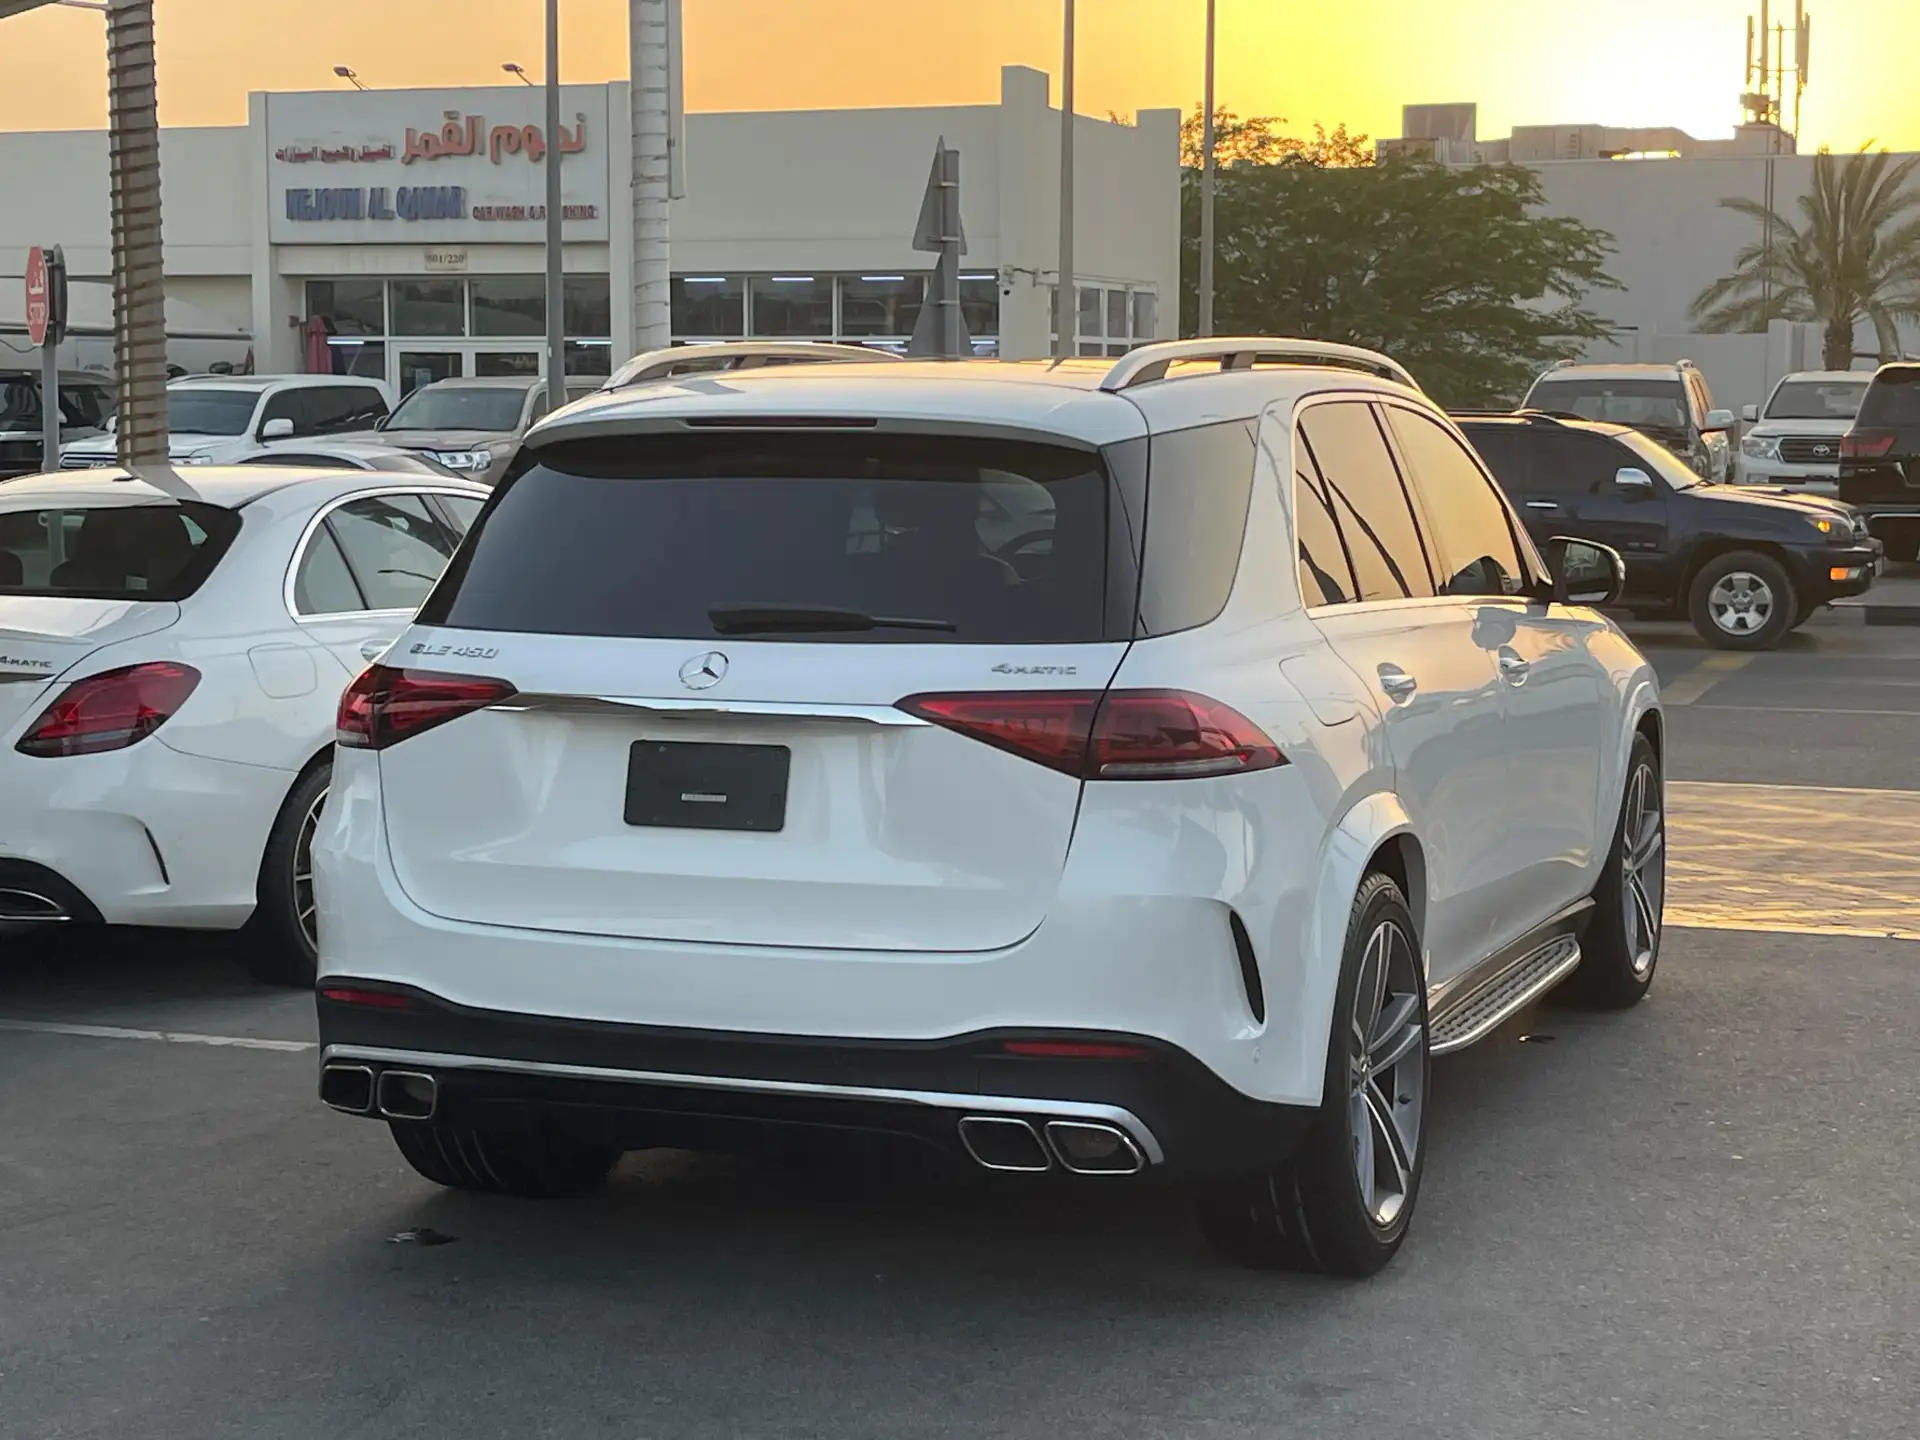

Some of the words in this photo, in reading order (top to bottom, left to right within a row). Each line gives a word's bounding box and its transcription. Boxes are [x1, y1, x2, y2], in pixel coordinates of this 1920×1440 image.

[401, 110, 485, 165] القمر
[285, 188, 365, 220] NEJOUM
[367, 187, 395, 220] AL
[396, 186, 467, 221] QAMAR
[472, 206, 493, 220] CAR
[495, 206, 525, 220] WASH
[528, 205, 537, 220] &
[29, 301, 46, 326] STOP
[410, 643, 452, 656] GLE
[452, 646, 499, 659] 450
[991, 662, 1077, 675] 4MATIC
